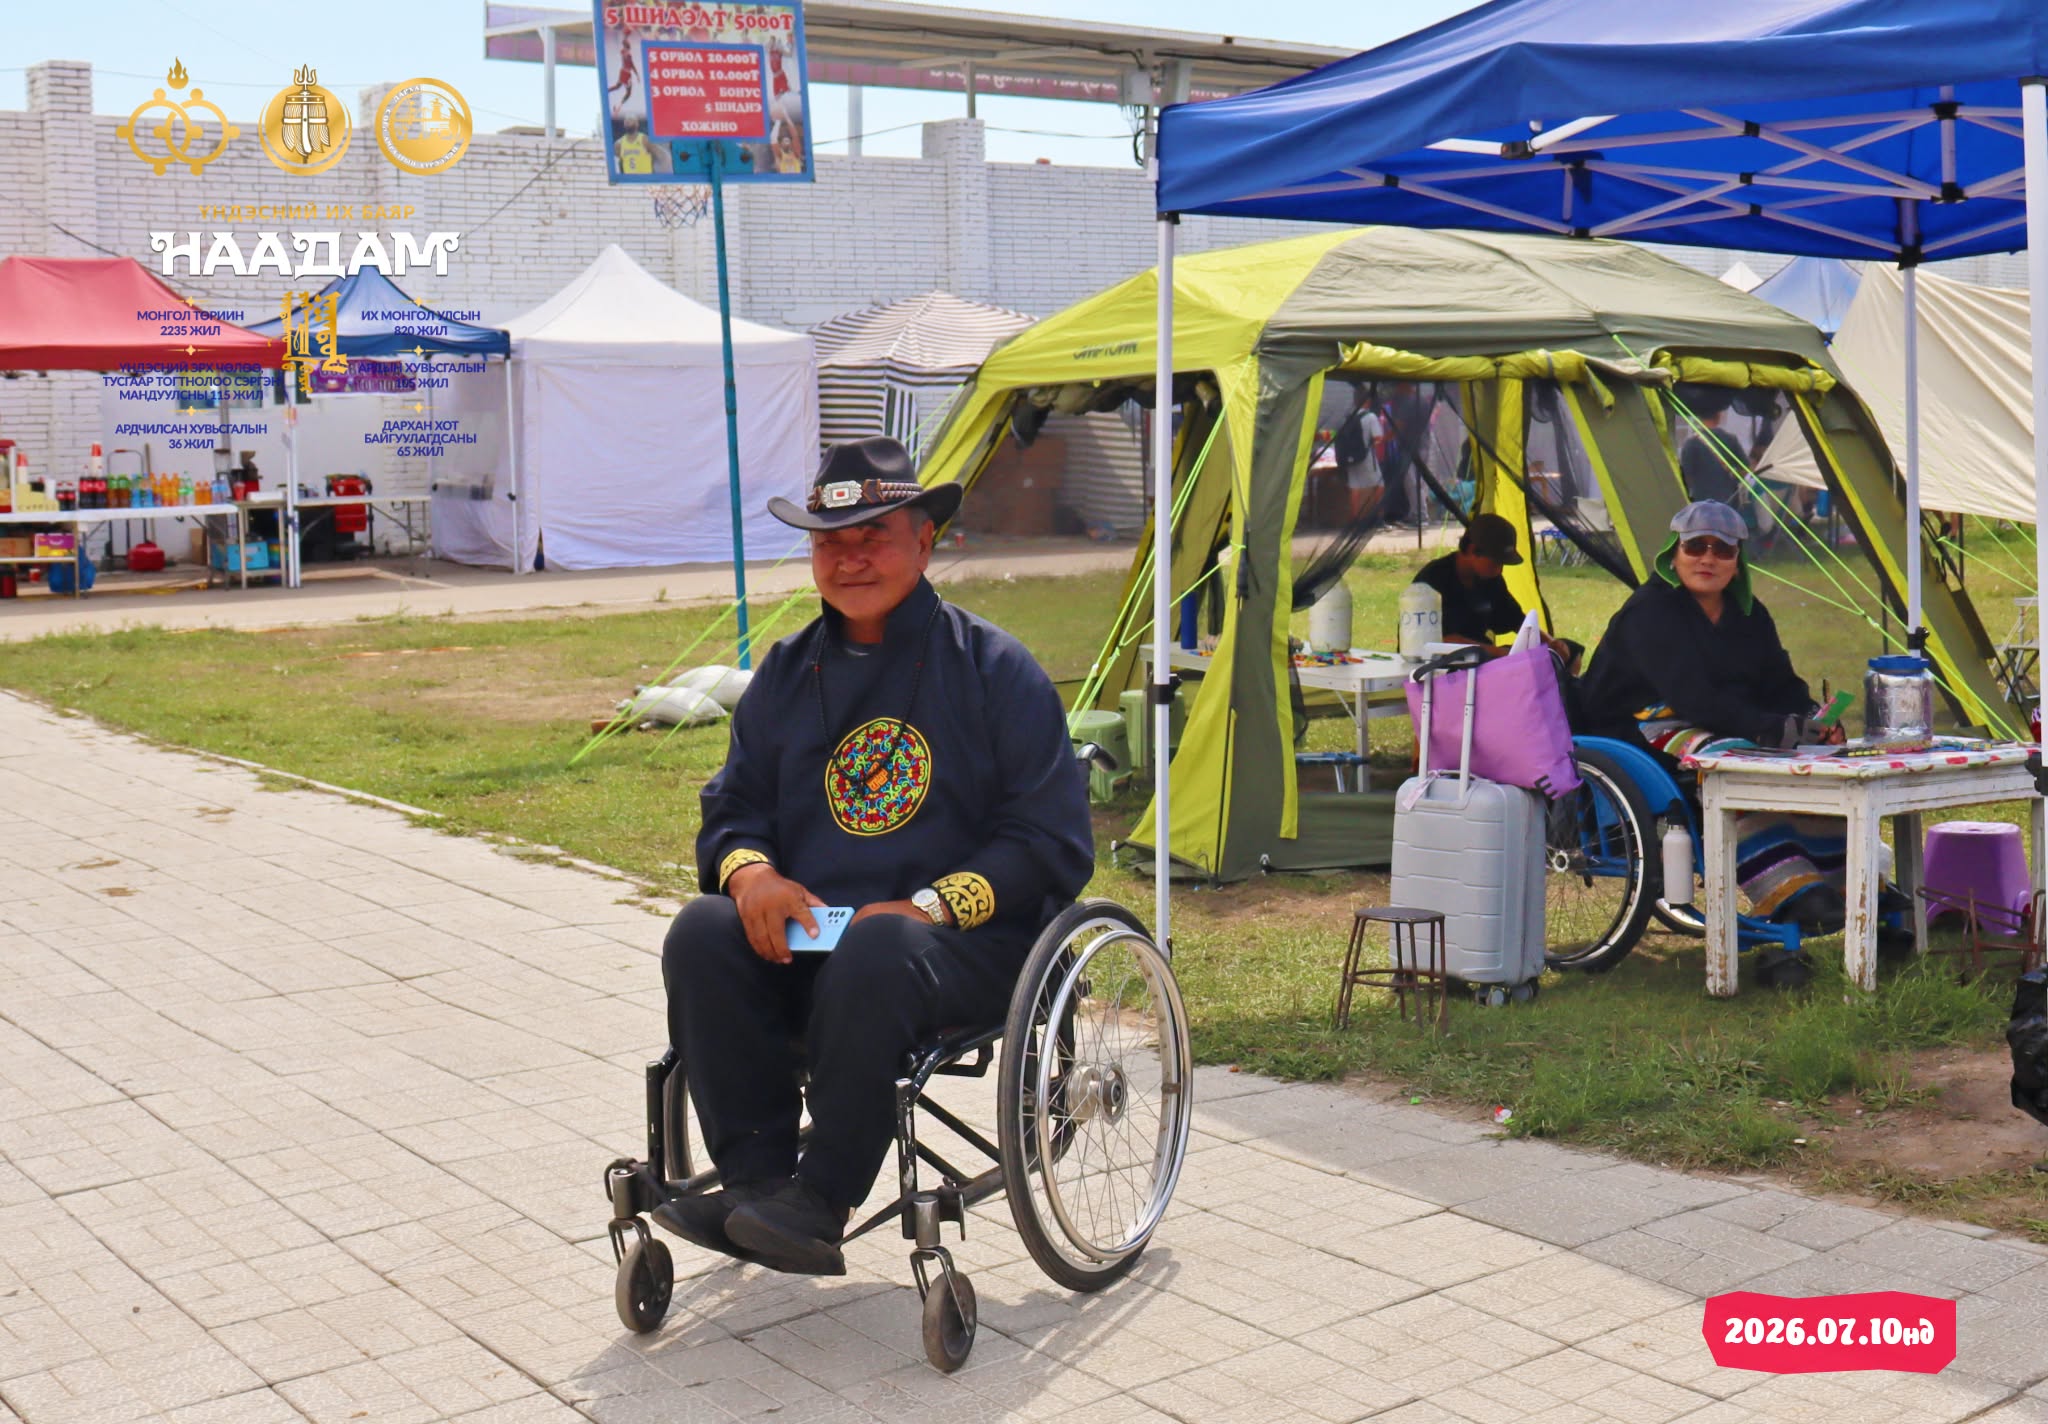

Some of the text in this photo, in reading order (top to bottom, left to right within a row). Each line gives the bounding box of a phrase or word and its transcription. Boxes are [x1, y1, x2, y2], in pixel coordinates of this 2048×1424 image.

[605, 9, 619, 25] 5
[625, 7, 728, 28] ШИДЭЛТ
[649, 51, 657, 63] 5
[650, 69, 659, 80] 4
[652, 86, 660, 97] 3
[719, 87, 761, 98] БОНУС
[704, 102, 712, 113] 5
